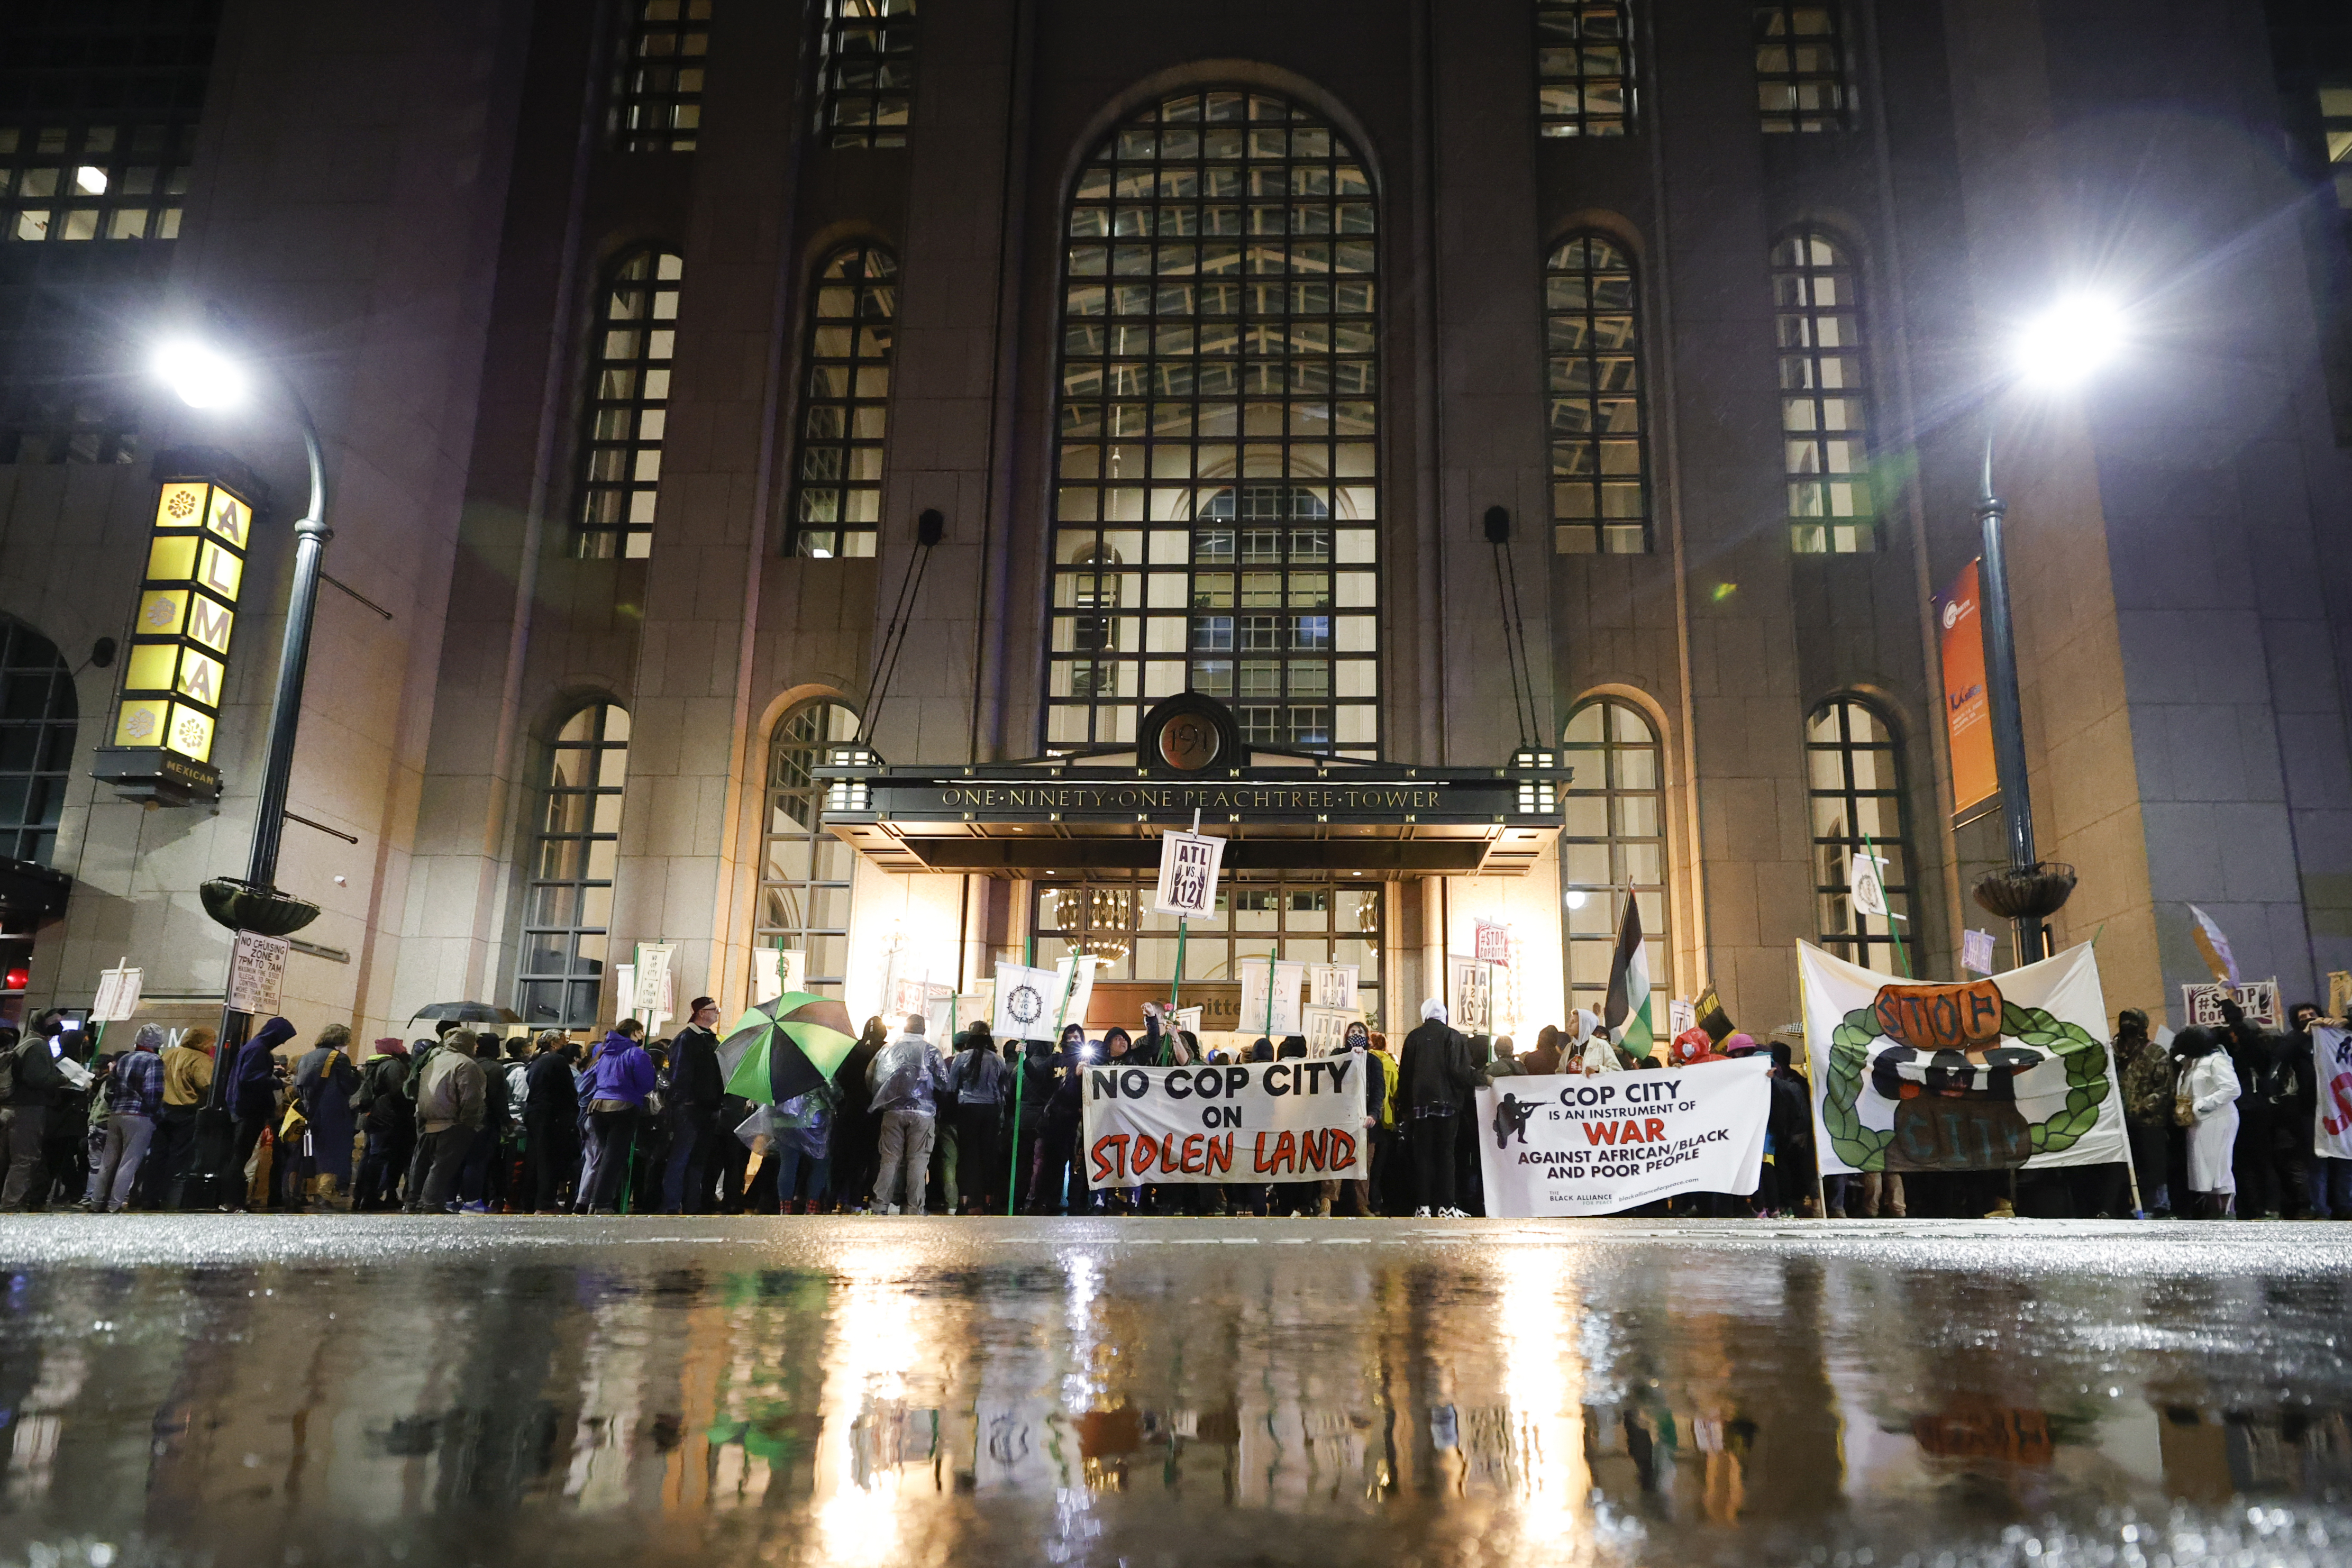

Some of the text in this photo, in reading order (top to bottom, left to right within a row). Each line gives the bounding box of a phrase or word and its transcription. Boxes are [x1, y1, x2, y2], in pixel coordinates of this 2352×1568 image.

[186, 500, 240, 703] ALMA
[1168, 724, 1207, 755] 191
[166, 760, 214, 786] MEXICAN
[1179, 845, 1206, 865] ATL
[1181, 880, 1197, 903] 12
[241, 936, 285, 954] NO CRUISING
[1481, 931, 1504, 946] #STOP
[238, 955, 282, 973] 7PM TO 7AM
[250, 949, 273, 961] ZONE
[239, 972, 256, 982] ILLEGAL
[239, 980, 258, 989] CONTROL
[2198, 989, 2256, 1010] #SOP
[1878, 991, 1995, 1040] STOP
[1092, 1060, 1352, 1100] NO COP CITY
[1560, 1080, 1681, 1107] COP CITY
[1202, 1106, 1242, 1128] ON
[1549, 1101, 1696, 1120] IS AN INSTRUMENT OF
[1582, 1118, 1667, 1145] WAR
[1904, 1113, 2020, 1163] CITY
[1091, 1128, 1356, 1182] STOLEN LAND
[1518, 1128, 1730, 1164] AGAINST AFRICAN/BLACK
[1547, 1148, 1700, 1179] AND POOR PEOPLE
[1618, 1178, 1699, 1202] blackallianceforpeace.com
